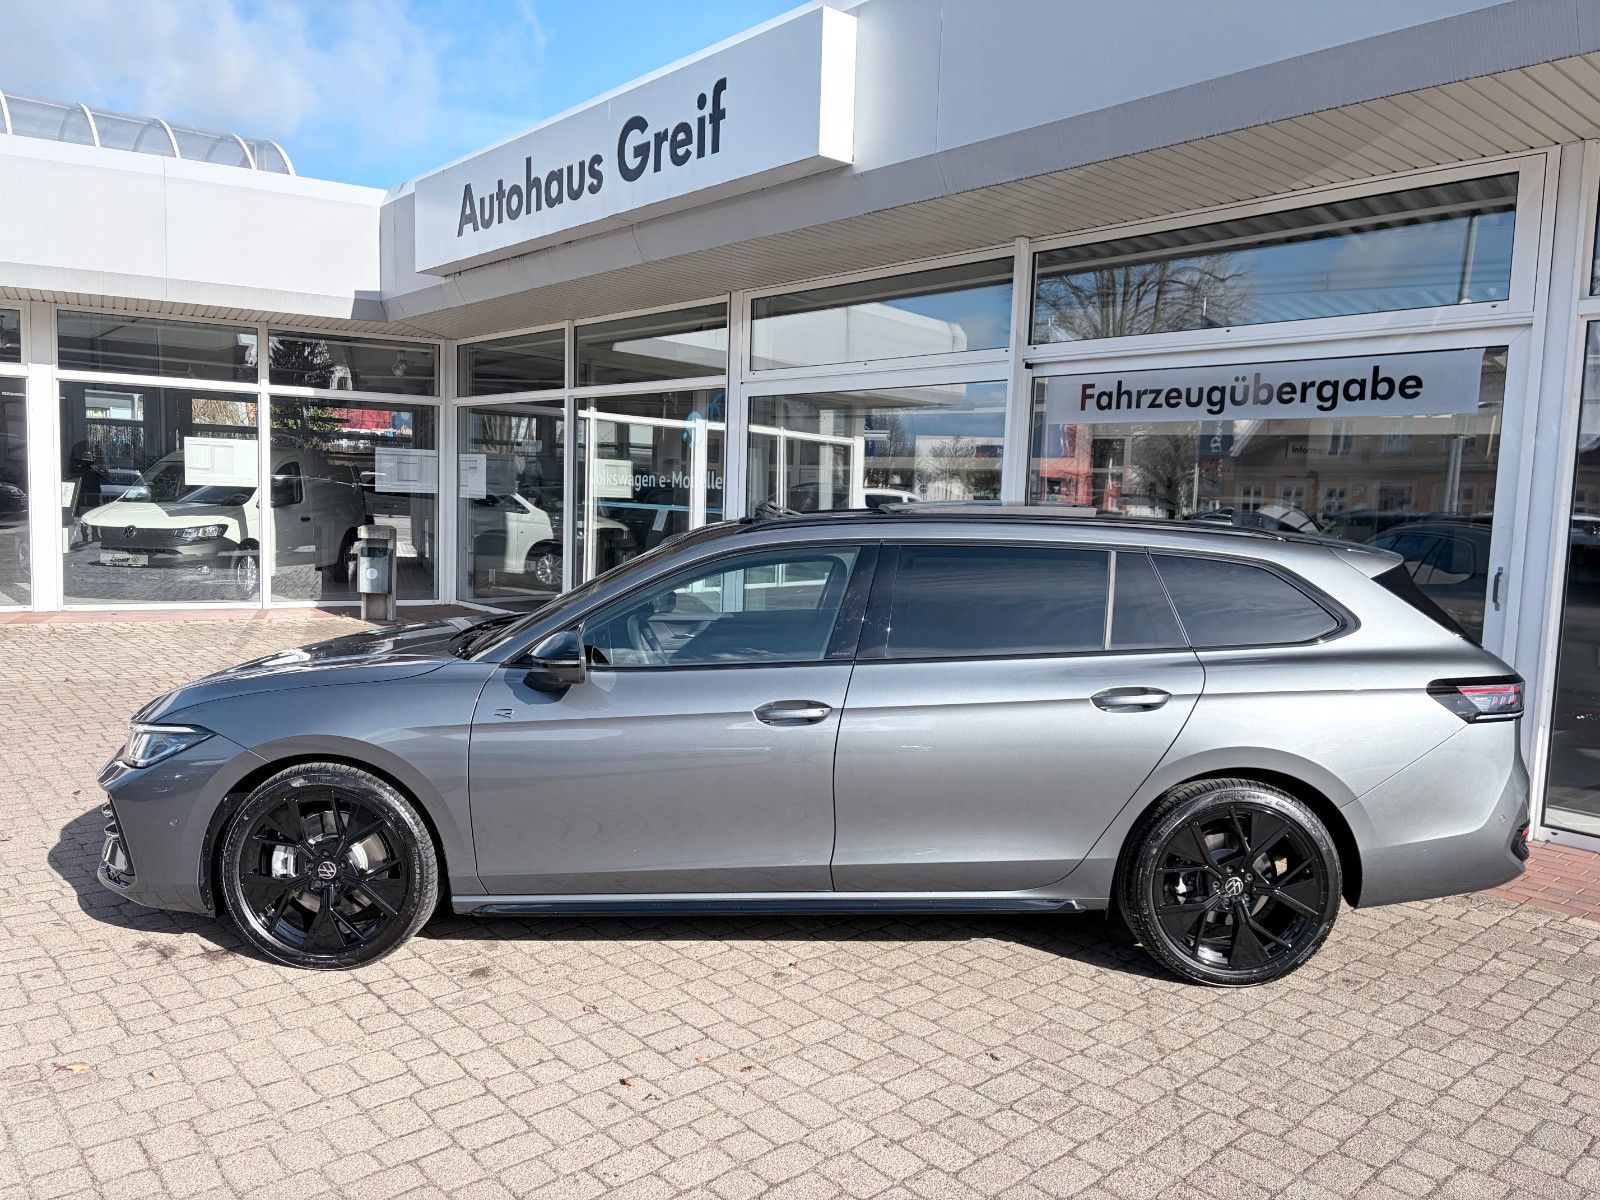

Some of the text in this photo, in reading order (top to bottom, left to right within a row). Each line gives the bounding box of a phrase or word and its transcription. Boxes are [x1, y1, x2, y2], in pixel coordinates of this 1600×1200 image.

[457, 77, 727, 238] Autohaus Greif
[1080, 365, 1423, 415] Fahrzeugübergabe
[659, 470, 723, 490] e-Molle
